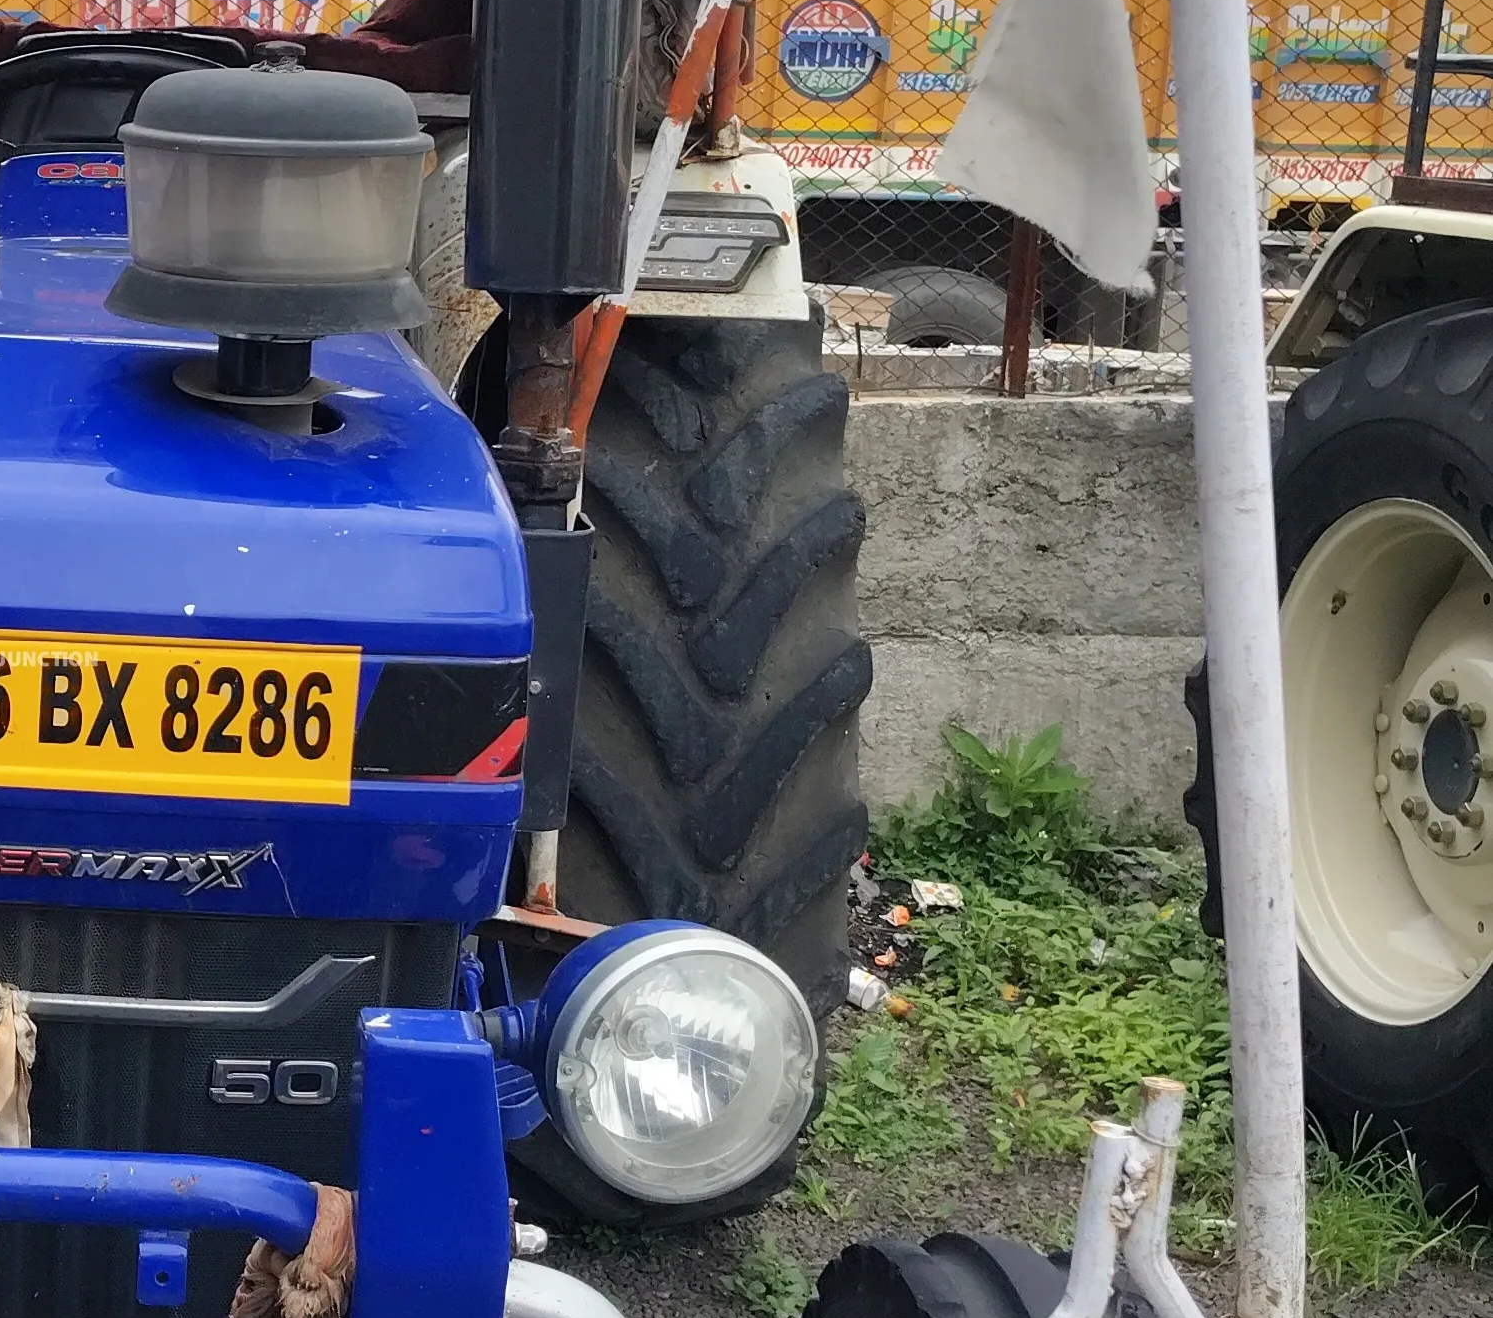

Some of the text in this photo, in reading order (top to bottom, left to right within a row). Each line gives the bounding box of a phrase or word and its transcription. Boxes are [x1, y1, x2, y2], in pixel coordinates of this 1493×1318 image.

[39, 657, 135, 749] BX
[160, 664, 334, 760] 8286
[209, 1059, 339, 1105] 50
